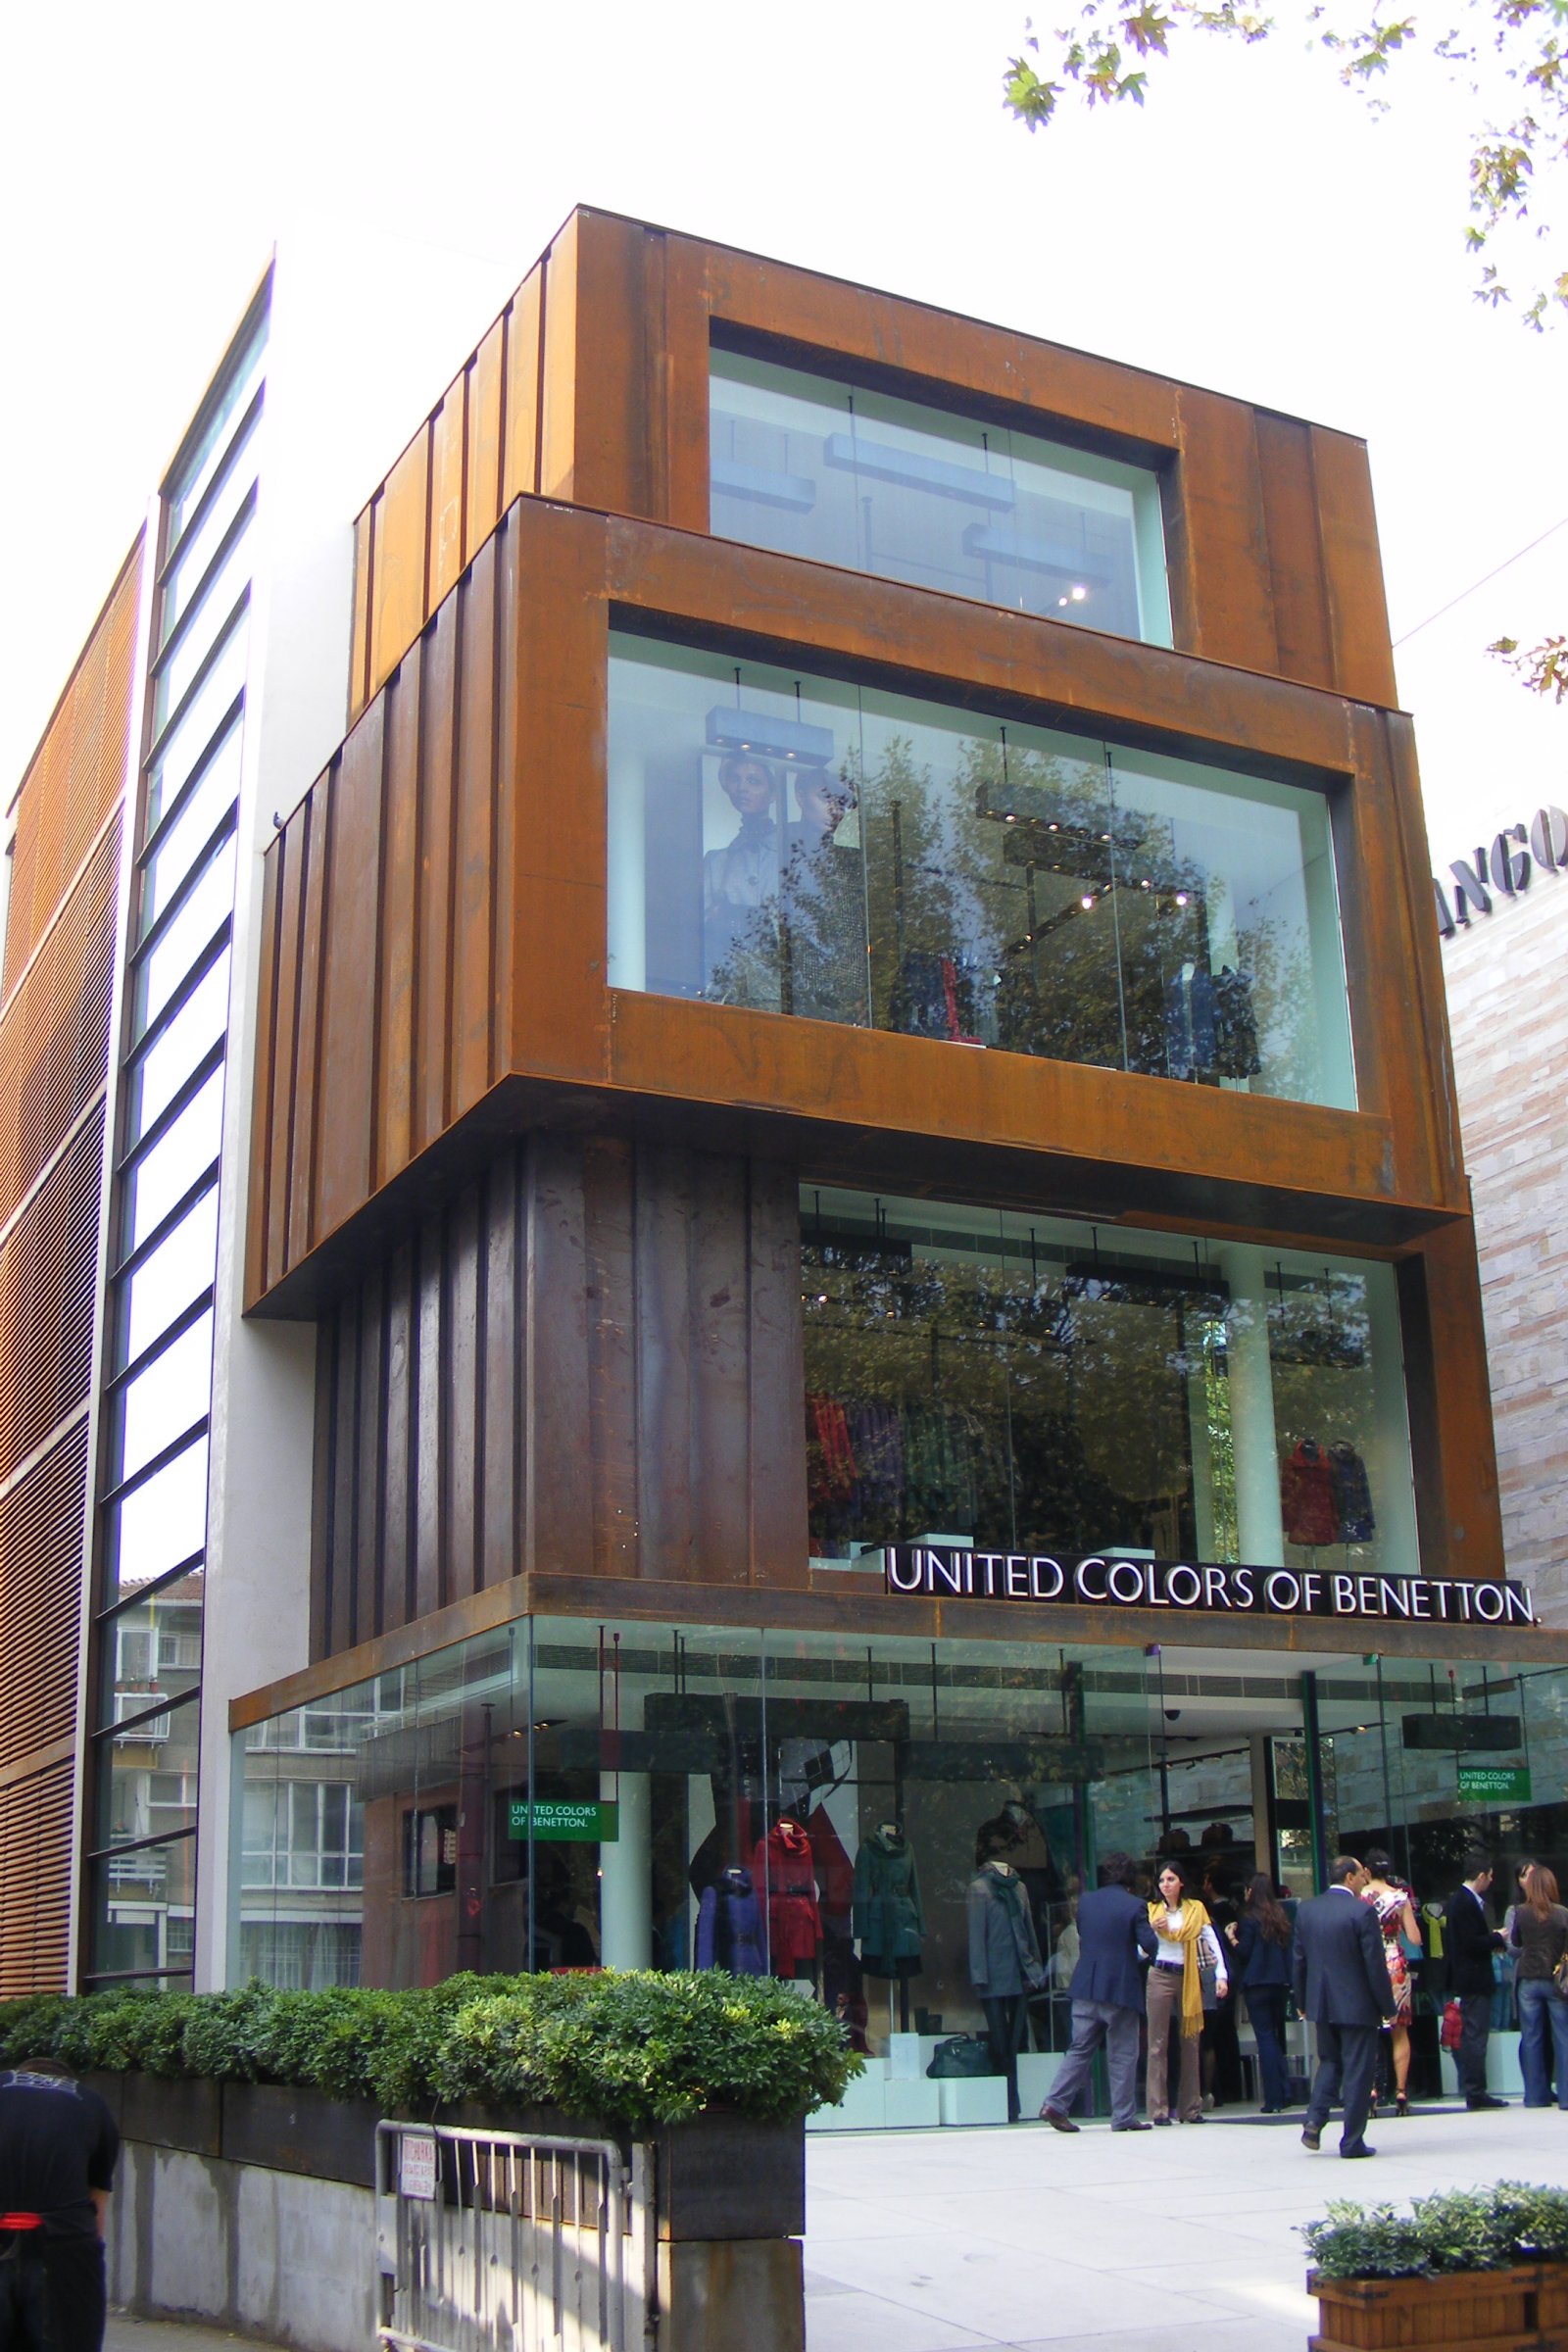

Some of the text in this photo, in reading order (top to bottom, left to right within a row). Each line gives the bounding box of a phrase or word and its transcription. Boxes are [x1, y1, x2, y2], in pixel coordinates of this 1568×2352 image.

[888, 1546, 1543, 1624] UNITED COLORS OF BENETTON.
[1459, 1771, 1516, 1781] UNITED COLORS
[1459, 1781, 1469, 1789] OF
[512, 1804, 597, 1817] UNTED COLORS
[512, 1816, 526, 1826] OF
